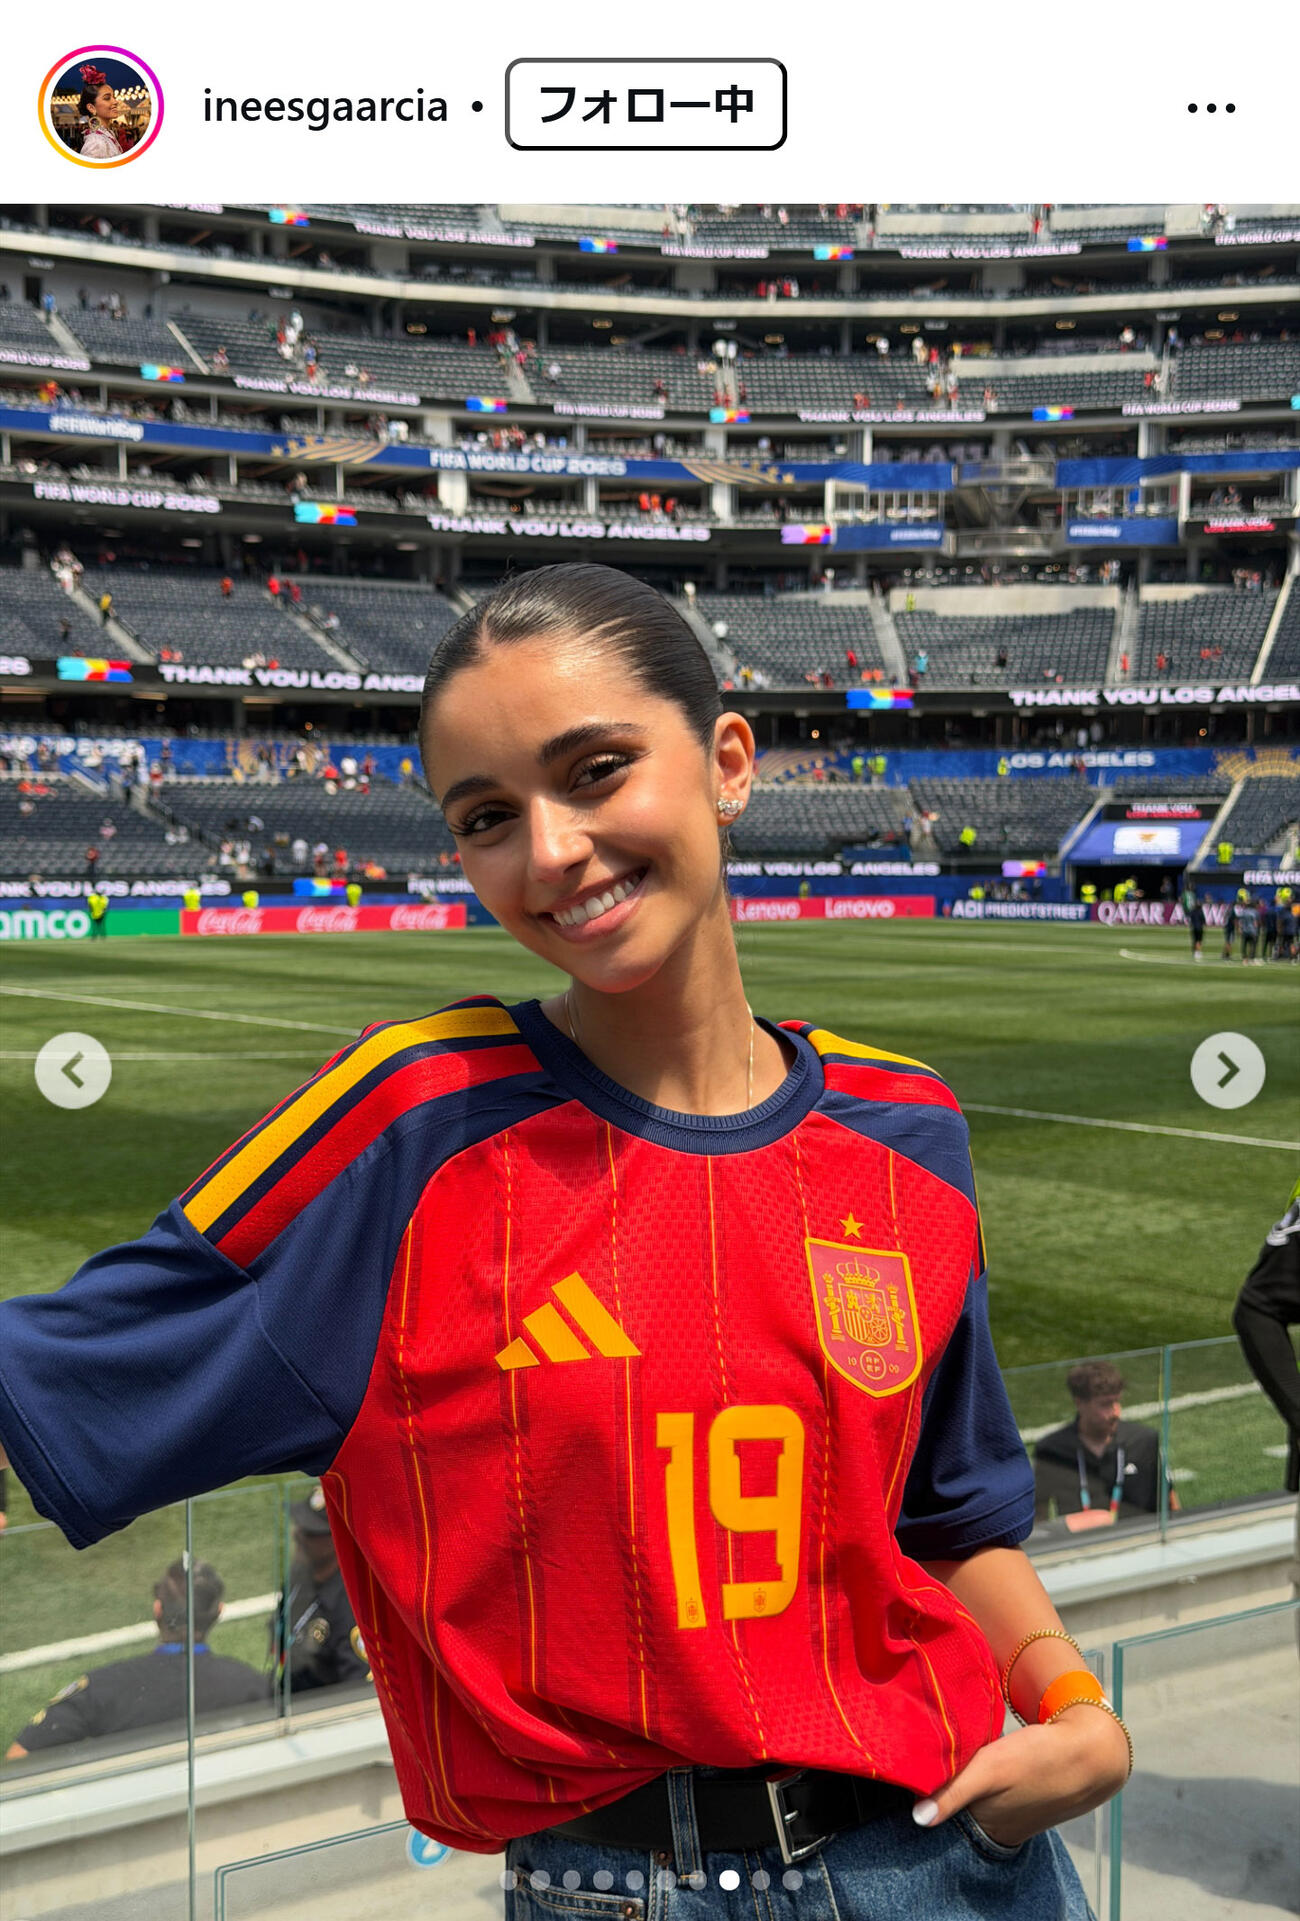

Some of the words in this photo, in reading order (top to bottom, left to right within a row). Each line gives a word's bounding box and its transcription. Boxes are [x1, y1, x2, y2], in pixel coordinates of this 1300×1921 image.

[430, 452, 468, 469] FIFA
[468, 454, 530, 471] WORLD
[532, 456, 566, 473] CUP
[34, 481, 71, 500] FIFA
[71, 484, 131, 505] WORLD
[427, 514, 507, 534] THANK
[509, 519, 559, 537] YOU
[559, 521, 606, 538] LOS
[607, 524, 711, 542] ANGELES
[159, 664, 253, 685] THANK
[254, 668, 310, 688] YOU
[310, 671, 362, 690] LOS
[1009, 689, 1100, 706] THANK
[1102, 687, 1159, 705] YOU
[1160, 687, 1214, 704] LOS
[824, 897, 896, 919] Lenovo
[1098, 901, 1165, 926] QATAR
[655, 1404, 806, 1630] 19
